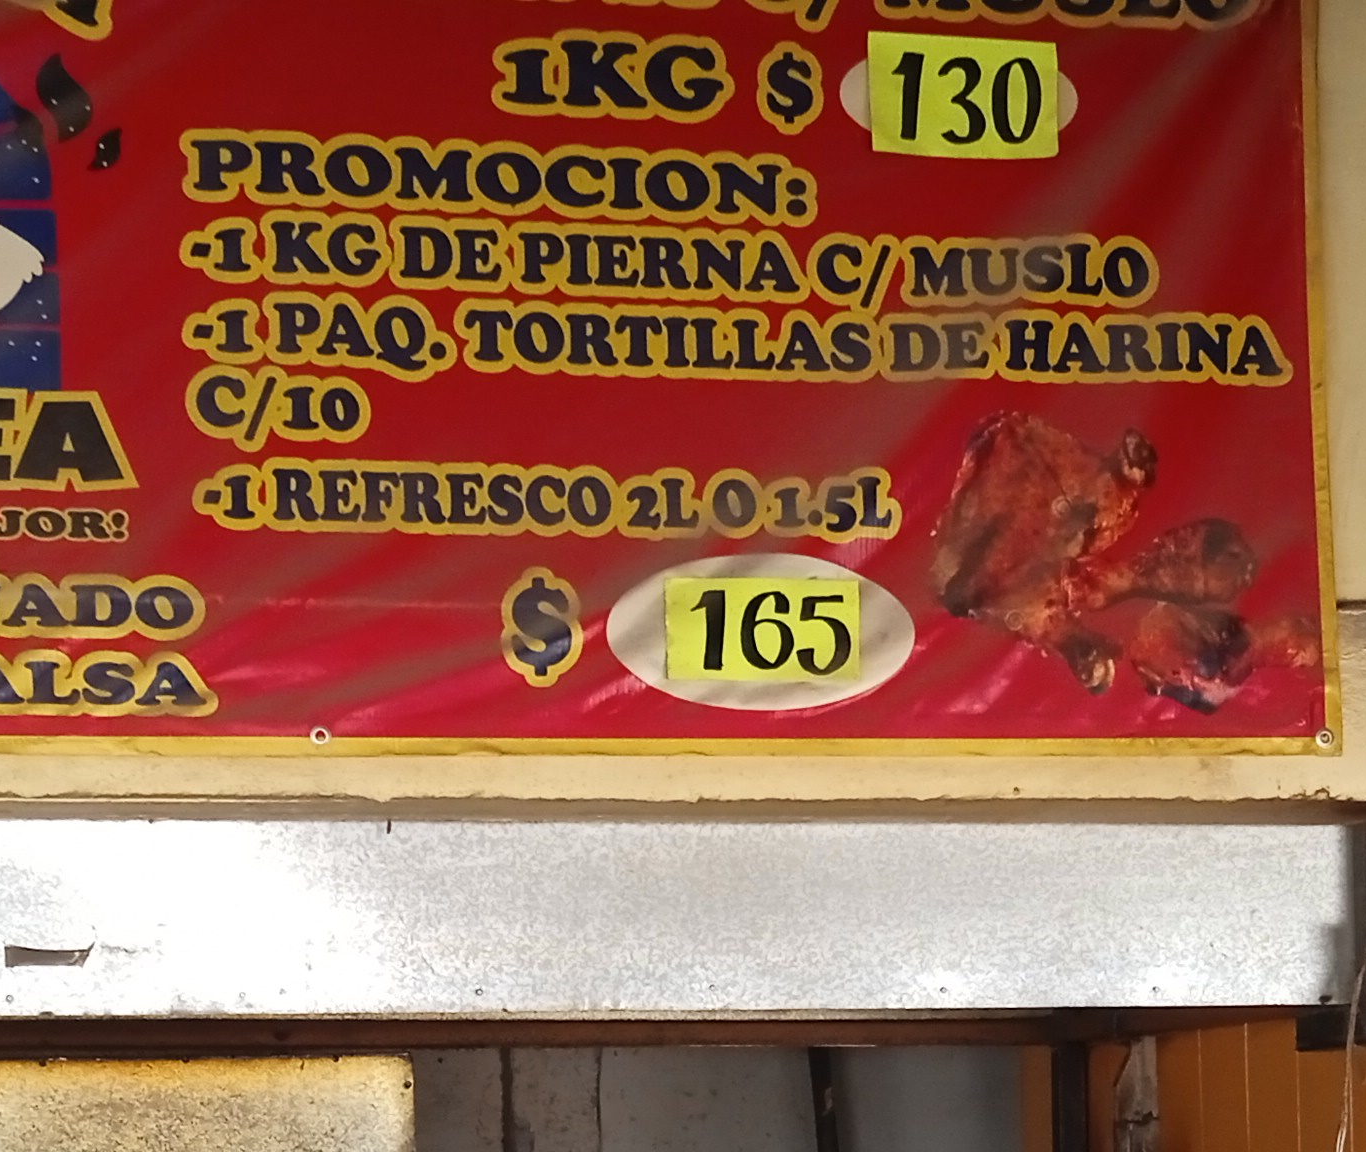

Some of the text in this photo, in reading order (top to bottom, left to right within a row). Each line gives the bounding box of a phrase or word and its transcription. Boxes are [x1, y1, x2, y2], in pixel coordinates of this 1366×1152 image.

[501, 38, 814, 124] 1KG $
[891, 51, 1043, 145] 130
[191, 139, 808, 216] PROMOCION:
[190, 221, 1151, 308] -1 KG DE PIERNA C/ MUSLO
[190, 302, 1283, 377] -1 PAQ. TORTILLAS DE HARINA
[195, 375, 361, 442] C/10
[204, 467, 894, 533] -1 REFRESCO 2L O 1.5L
[512, 576, 574, 677] $
[690, 589, 854, 677] 165
